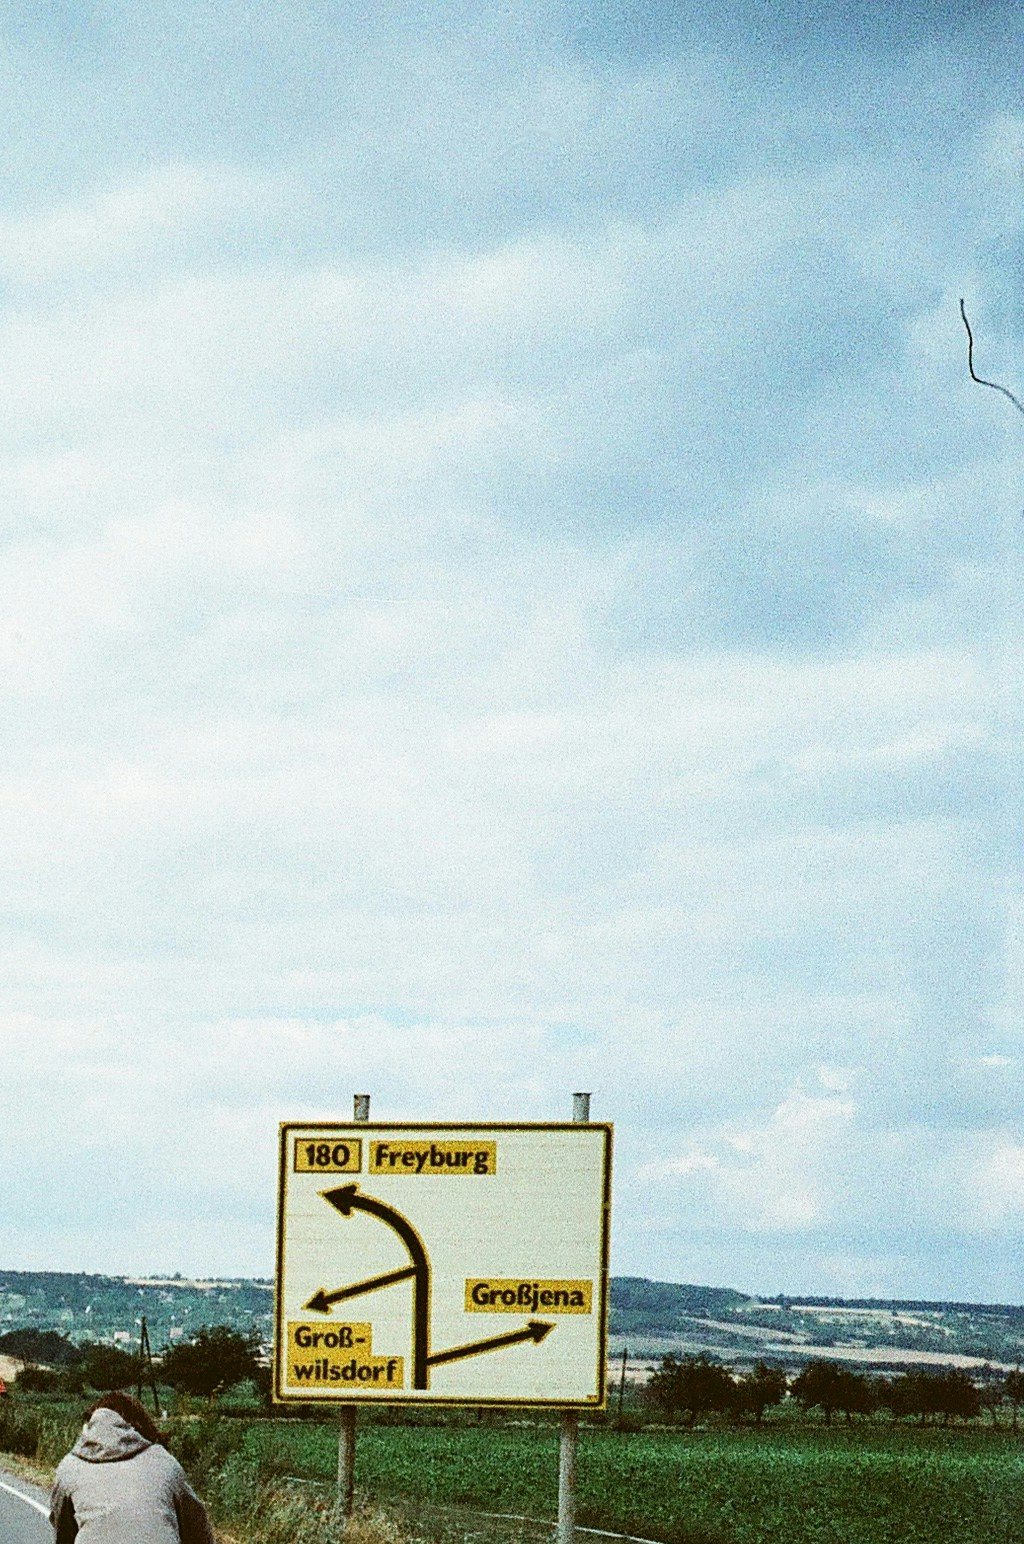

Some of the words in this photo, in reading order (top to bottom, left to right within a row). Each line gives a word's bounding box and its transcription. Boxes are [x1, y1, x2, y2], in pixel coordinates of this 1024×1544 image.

[306, 1144, 351, 1167] 180
[375, 1144, 489, 1174] Freyburg
[471, 1282, 585, 1312] Großjena
[294, 1326, 367, 1348] Groß-
[294, 1359, 398, 1382] wilsdorf
